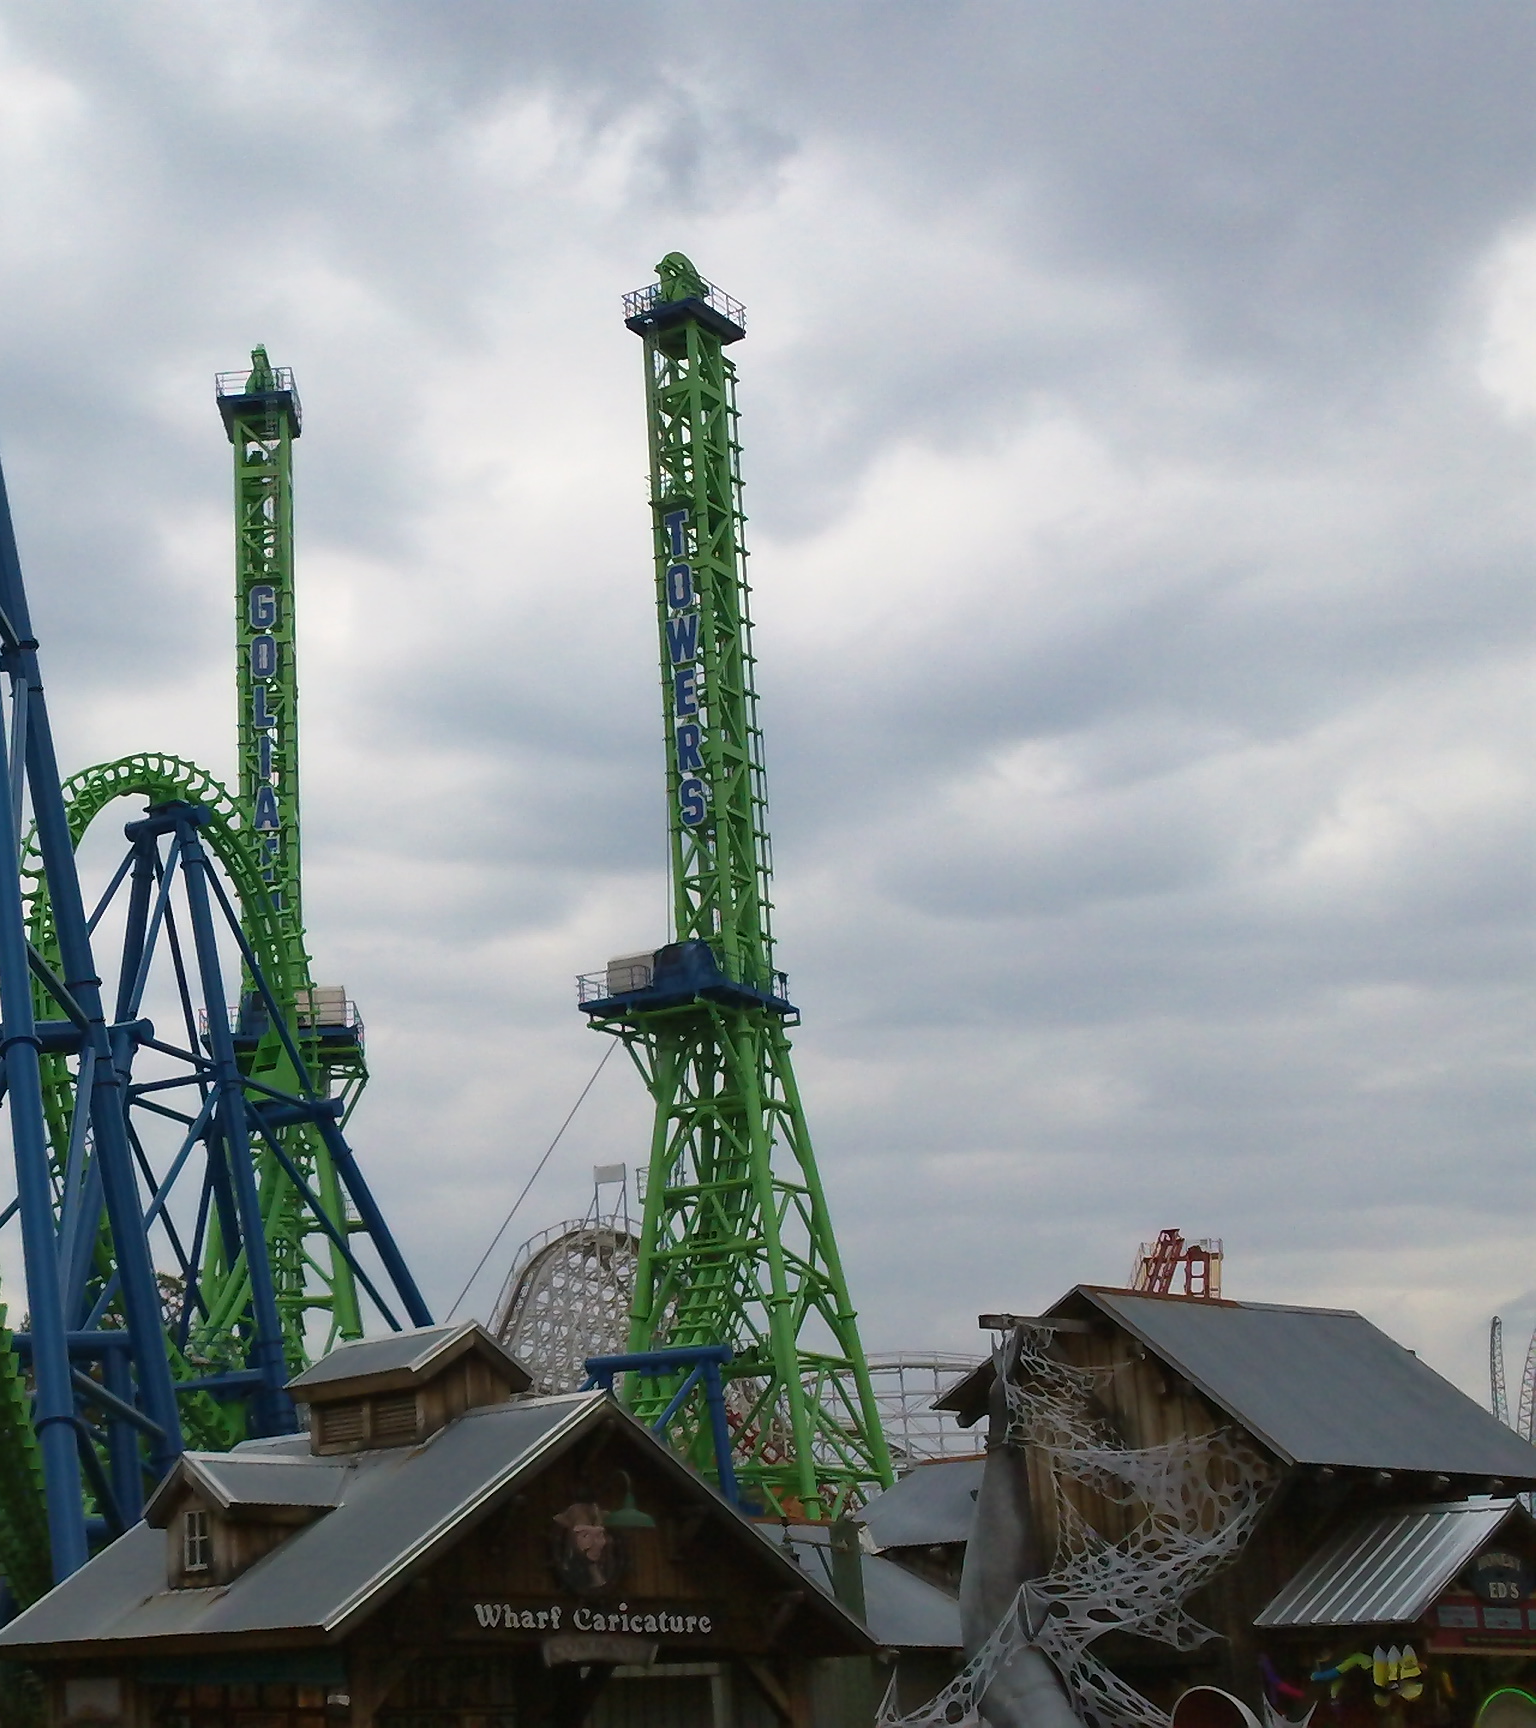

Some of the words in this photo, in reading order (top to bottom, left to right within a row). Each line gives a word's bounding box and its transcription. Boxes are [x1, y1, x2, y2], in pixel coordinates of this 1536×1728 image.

[664, 509, 709, 827] TOWERS
[474, 1603, 562, 1629] Wharf
[572, 1602, 712, 1633] Caricature
